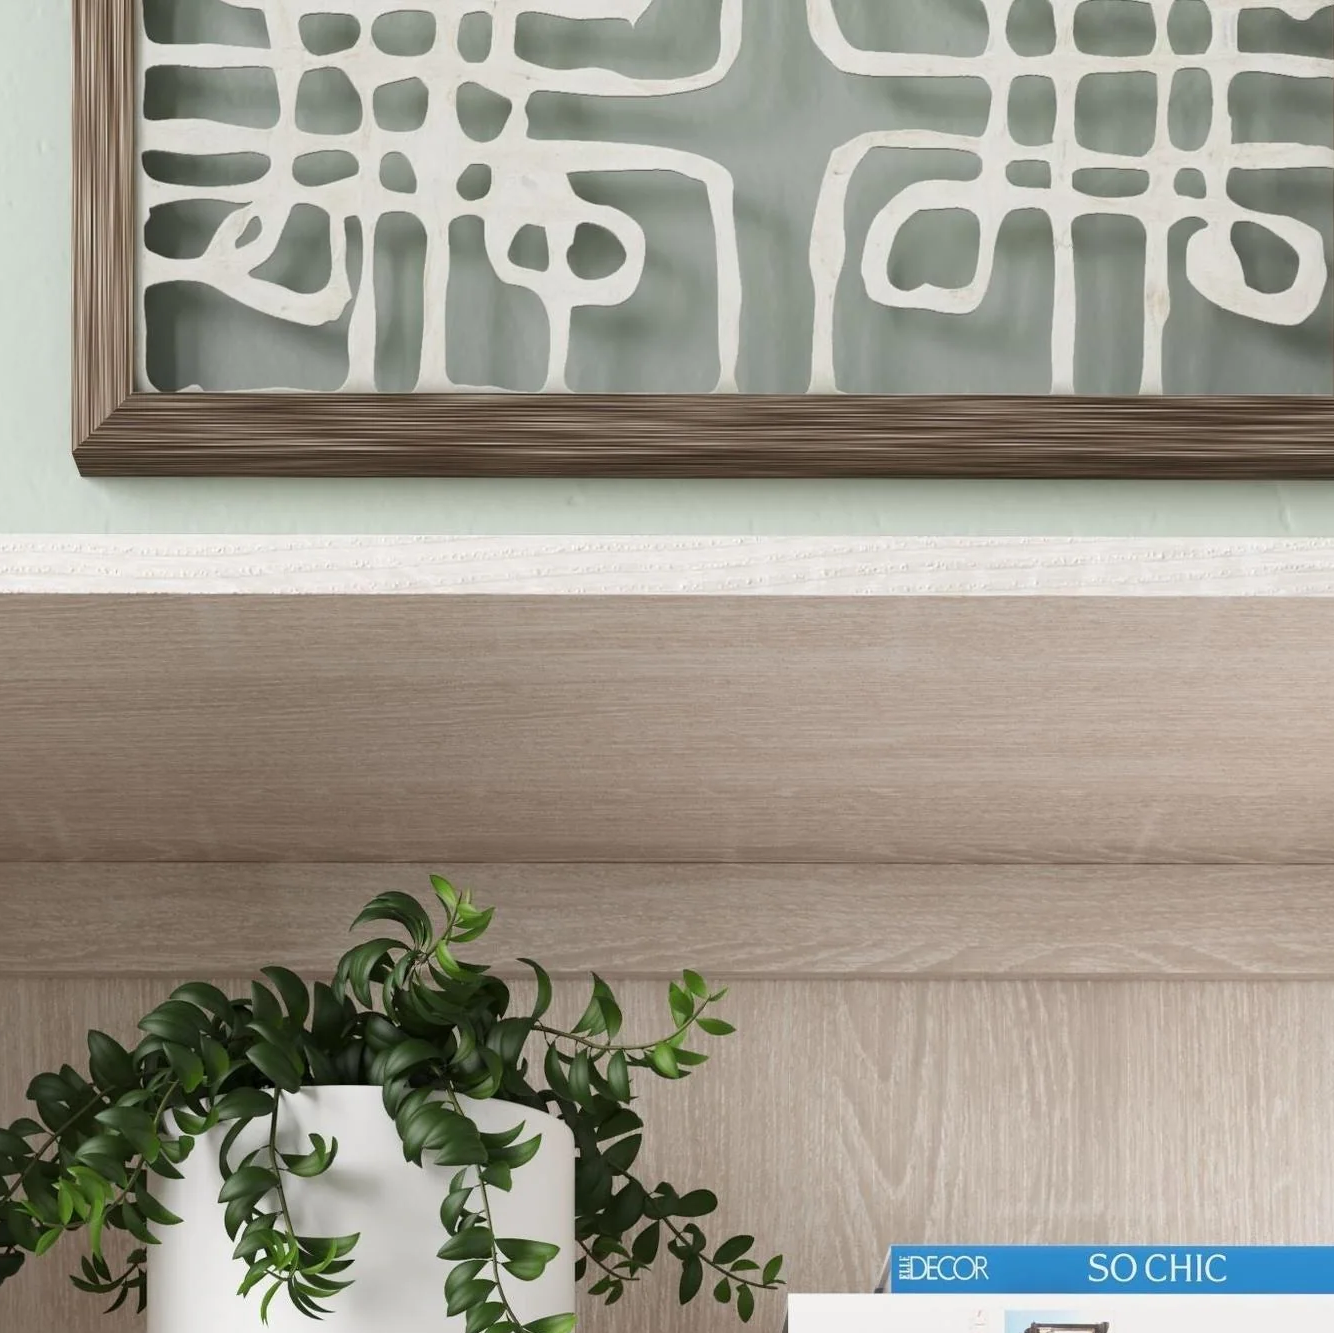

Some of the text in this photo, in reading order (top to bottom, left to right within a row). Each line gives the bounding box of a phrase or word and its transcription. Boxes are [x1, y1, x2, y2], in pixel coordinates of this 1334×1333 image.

[899, 1255, 989, 1280] ELLE DECOR
[1088, 1253, 1228, 1282] SO CHIC
